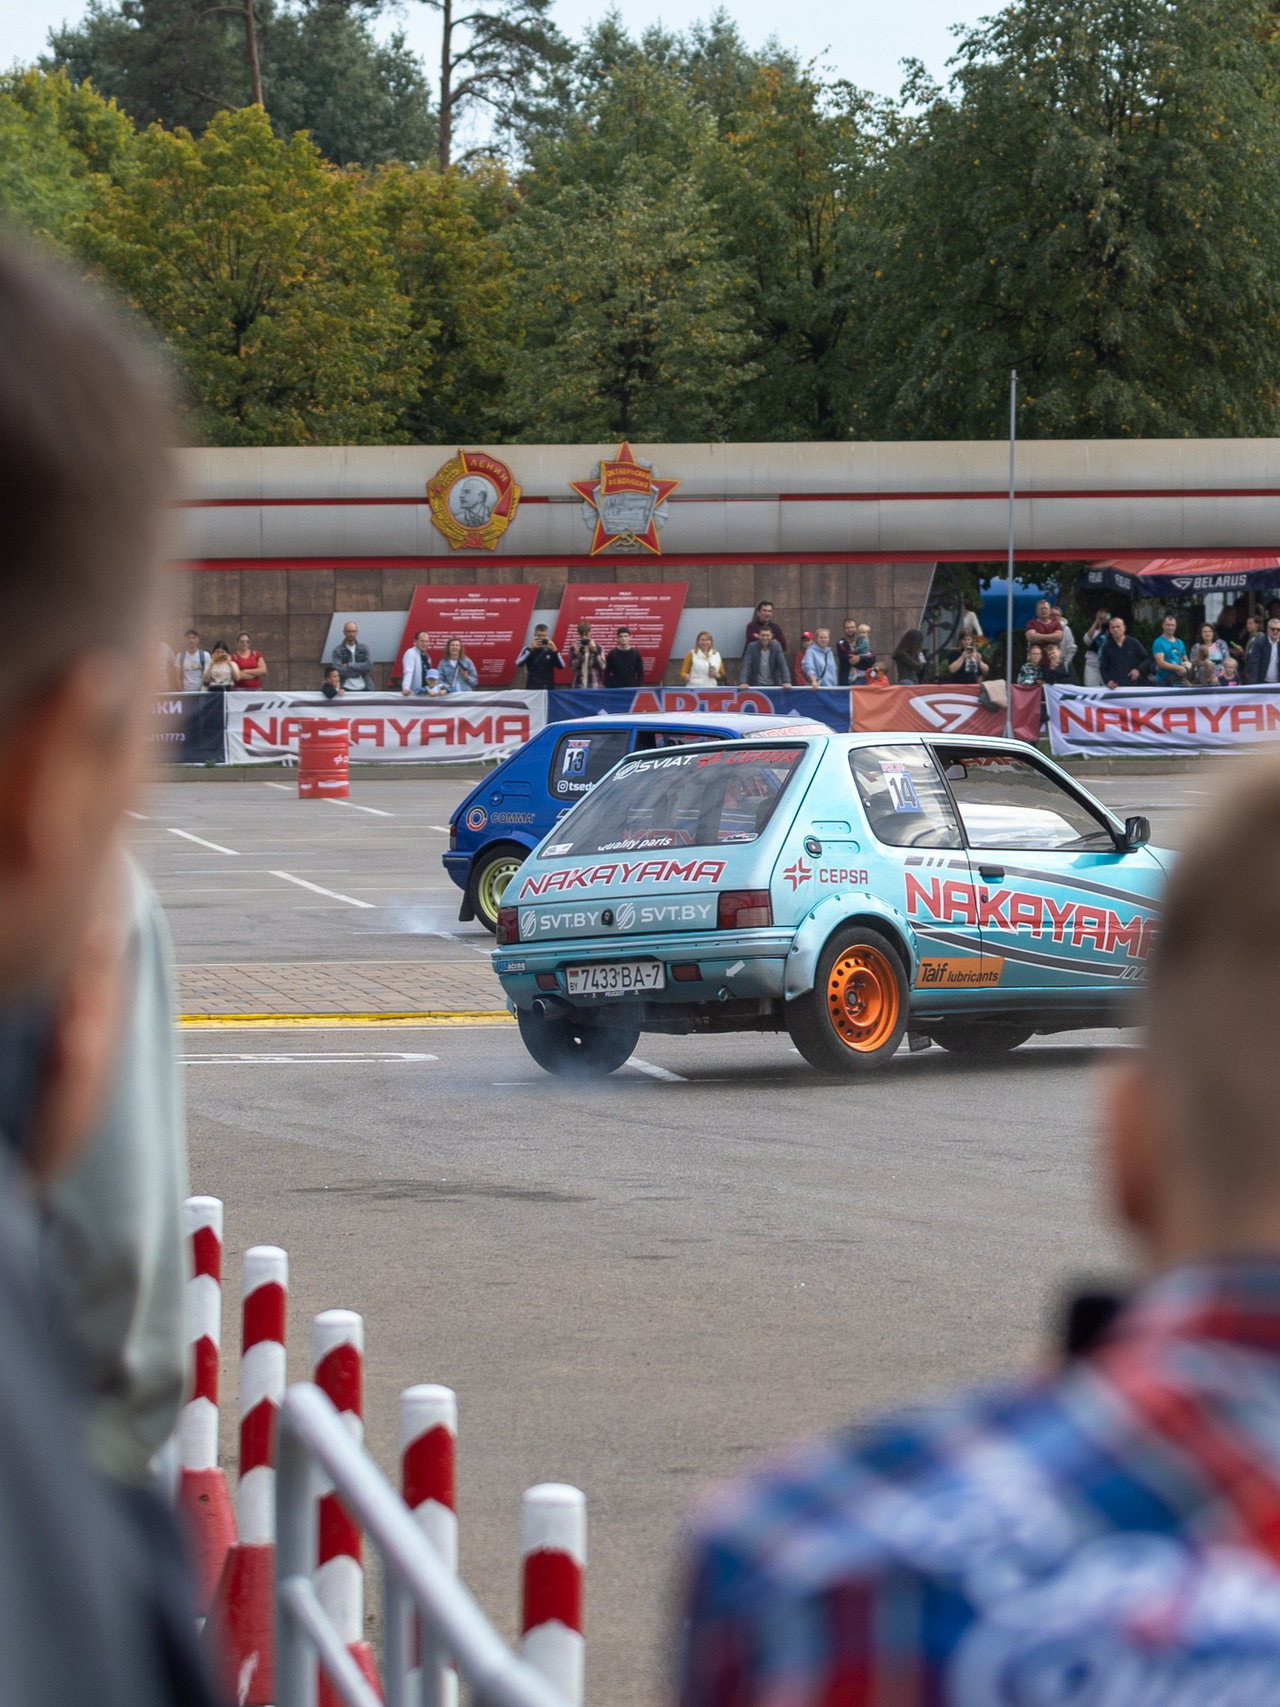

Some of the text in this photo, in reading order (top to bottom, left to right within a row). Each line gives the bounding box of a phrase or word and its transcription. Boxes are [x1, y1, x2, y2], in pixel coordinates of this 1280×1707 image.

[469, 458, 508, 483] ЛЕНИН
[1193, 573, 1248, 589] BELARUS
[242, 714, 530, 747] NAAYAMA
[567, 750, 585, 773] 13
[725, 750, 801, 765] CEPSA
[888, 776, 918, 809] 14
[491, 812, 534, 824] COMMA
[637, 837, 673, 850] parts
[518, 858, 729, 900] NAKAYAMA
[819, 868, 869, 885] CEPSA
[540, 910, 600, 931] SVT.BY
[640, 903, 713, 923] SVT.BY
[581, 964, 661, 991] 7433 BA-7
[921, 962, 1000, 983] Taif lubricants
[569, 982, 579, 992] BY
